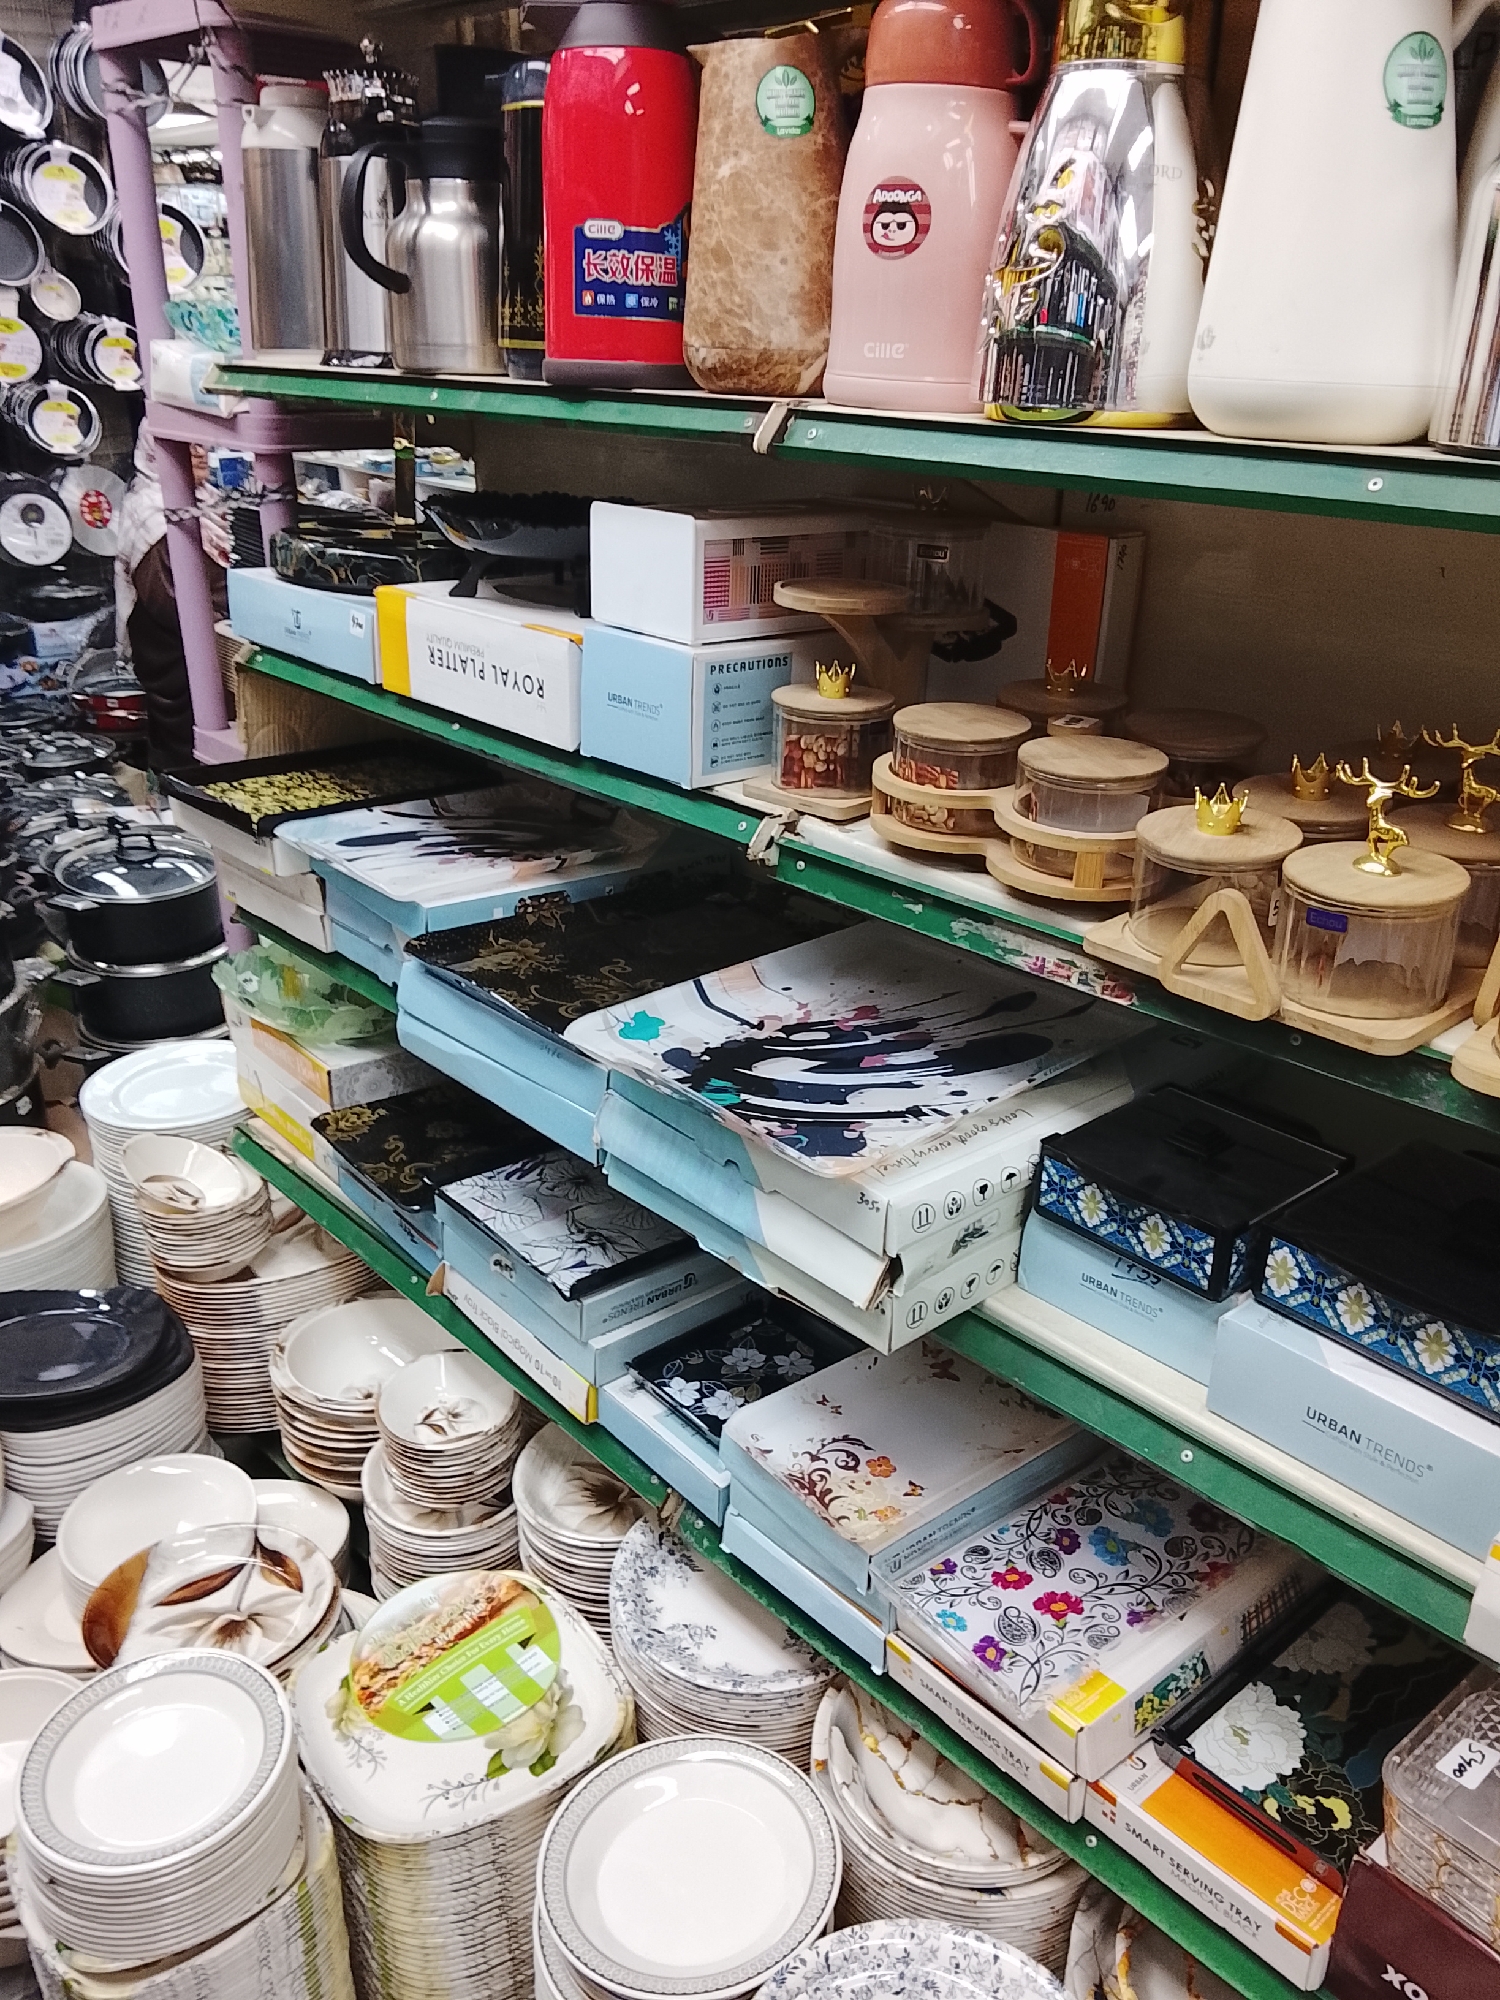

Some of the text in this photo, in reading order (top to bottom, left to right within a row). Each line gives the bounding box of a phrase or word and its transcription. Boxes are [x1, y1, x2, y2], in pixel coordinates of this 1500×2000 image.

[583, 248, 678, 286] 长效保温
[864, 342, 906, 359] Cille
[427, 644, 545, 699] ROYAL PLATTER
[710, 655, 789, 676] PRECAUTIONS
[607, 691, 633, 708] URBAN
[634, 698, 662, 716] TRENDS
[606, 1299, 646, 1323] TRENDS
[646, 1283, 683, 1306] URBAN
[1081, 1272, 1119, 1298] URBAN
[1119, 1291, 1161, 1319] TRENDS
[500, 1329, 533, 1363] Magical
[1306, 1406, 1430, 1478] URBAN TRENDS
[921, 1679, 1031, 1772] SMART SERVING TRAY
[1127, 1773, 1149, 1791] URBAN
[1125, 1821, 1165, 1860] SMART
[1168, 1855, 1225, 1906] SERVING
[1229, 1901, 1263, 1931] TRAY
[1170, 1869, 1258, 1941] MAGICAL BLACK
[1381, 1963, 1430, 2000] XO
